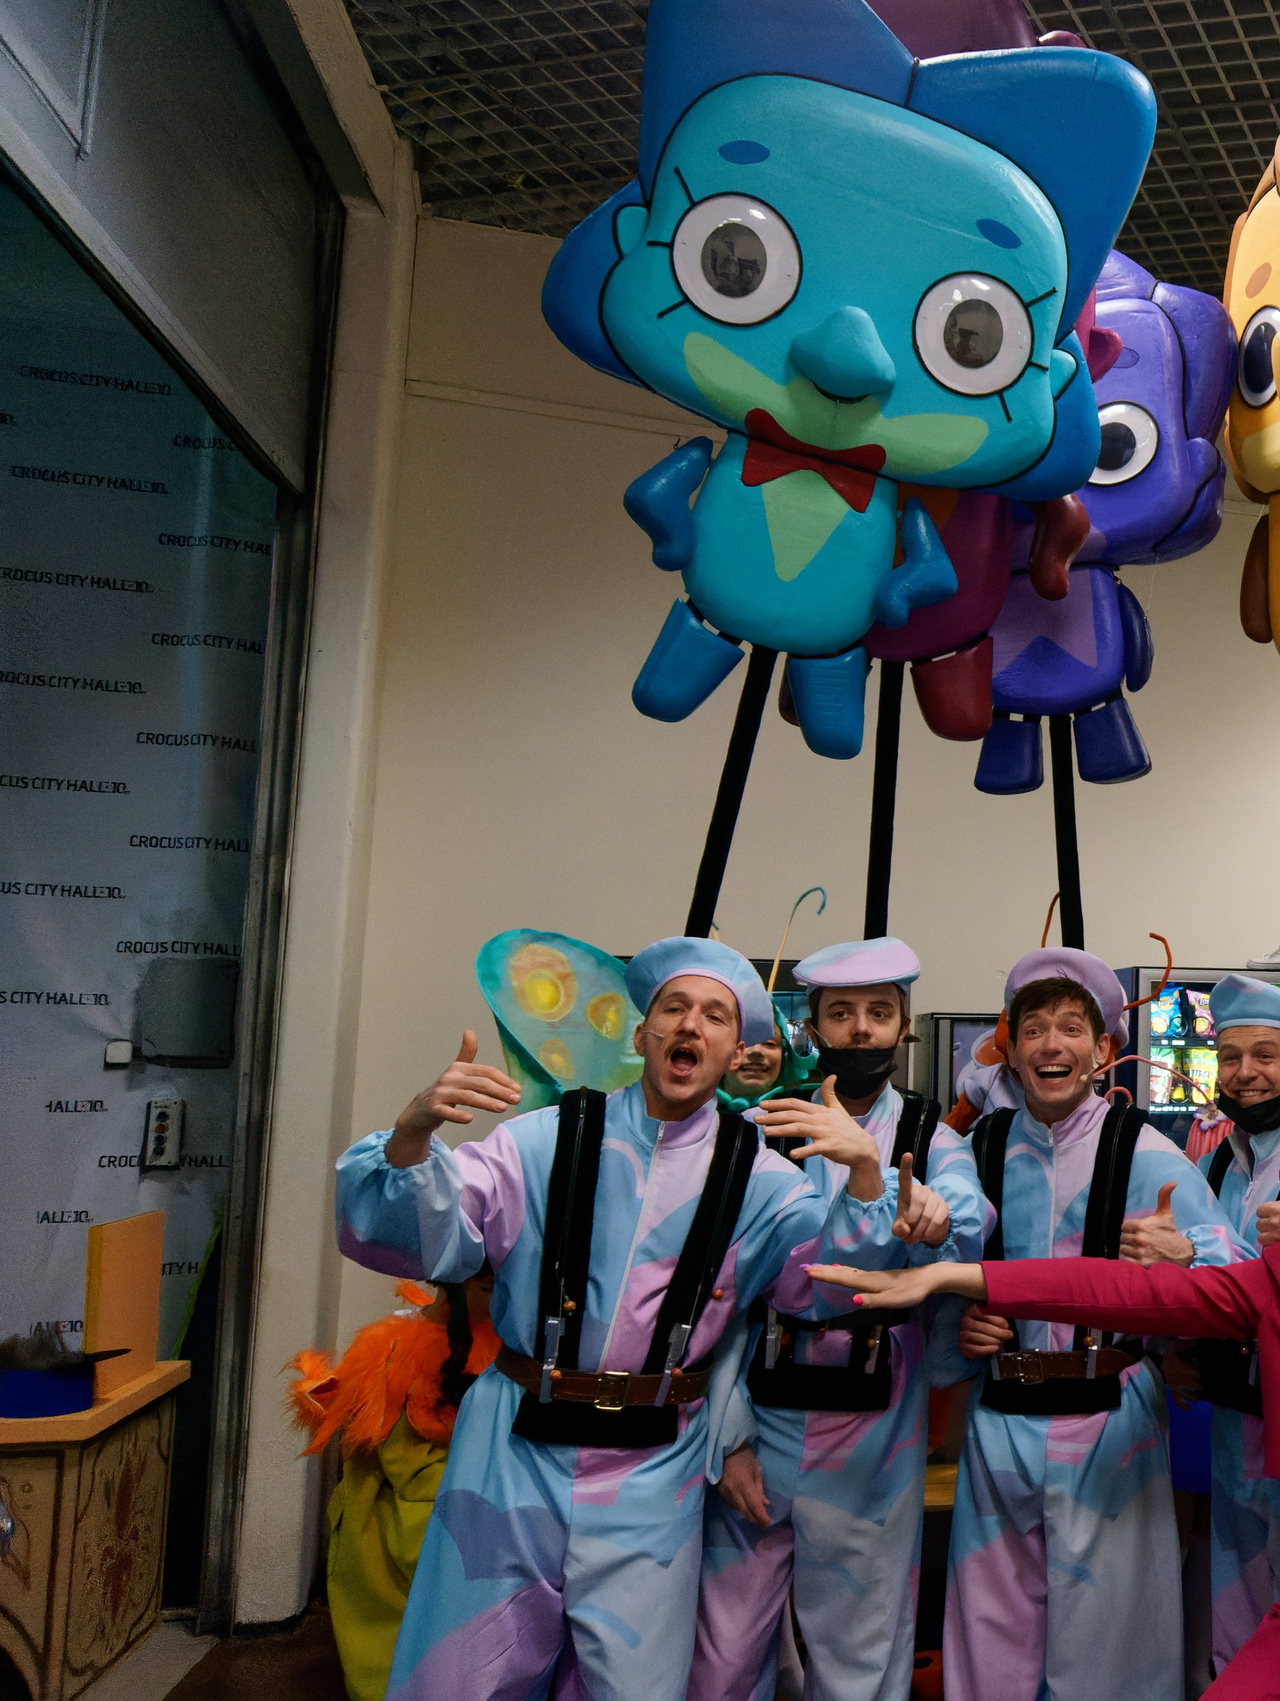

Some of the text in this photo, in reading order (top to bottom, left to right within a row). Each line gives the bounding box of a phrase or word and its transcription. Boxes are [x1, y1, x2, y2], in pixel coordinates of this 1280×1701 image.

[158, 533, 271, 556] CROCUS CITY HAL
[0, 567, 53, 585] ROCUS
[55, 573, 88, 588] CITY
[151, 633, 265, 655] CROCUS CITY HAL
[48, 675, 81, 689] CITY
[136, 732, 190, 747] CROCUS
[190, 733, 219, 747] CITY
[31, 777, 64, 791] CITY
[129, 835, 185, 850] CROCUS
[185, 836, 213, 850] CITY
[24, 883, 58, 897] CITY
[60, 885, 99, 898] HALL
[115, 940, 241, 956] CROCUS CITY HALL
[10, 991, 44, 1005] CITY
[45, 991, 84, 1006] HALL
[98, 1155, 138, 1168] CROC
[36, 1209, 69, 1224] ALL
[162, 1261, 186, 1276] ITY
